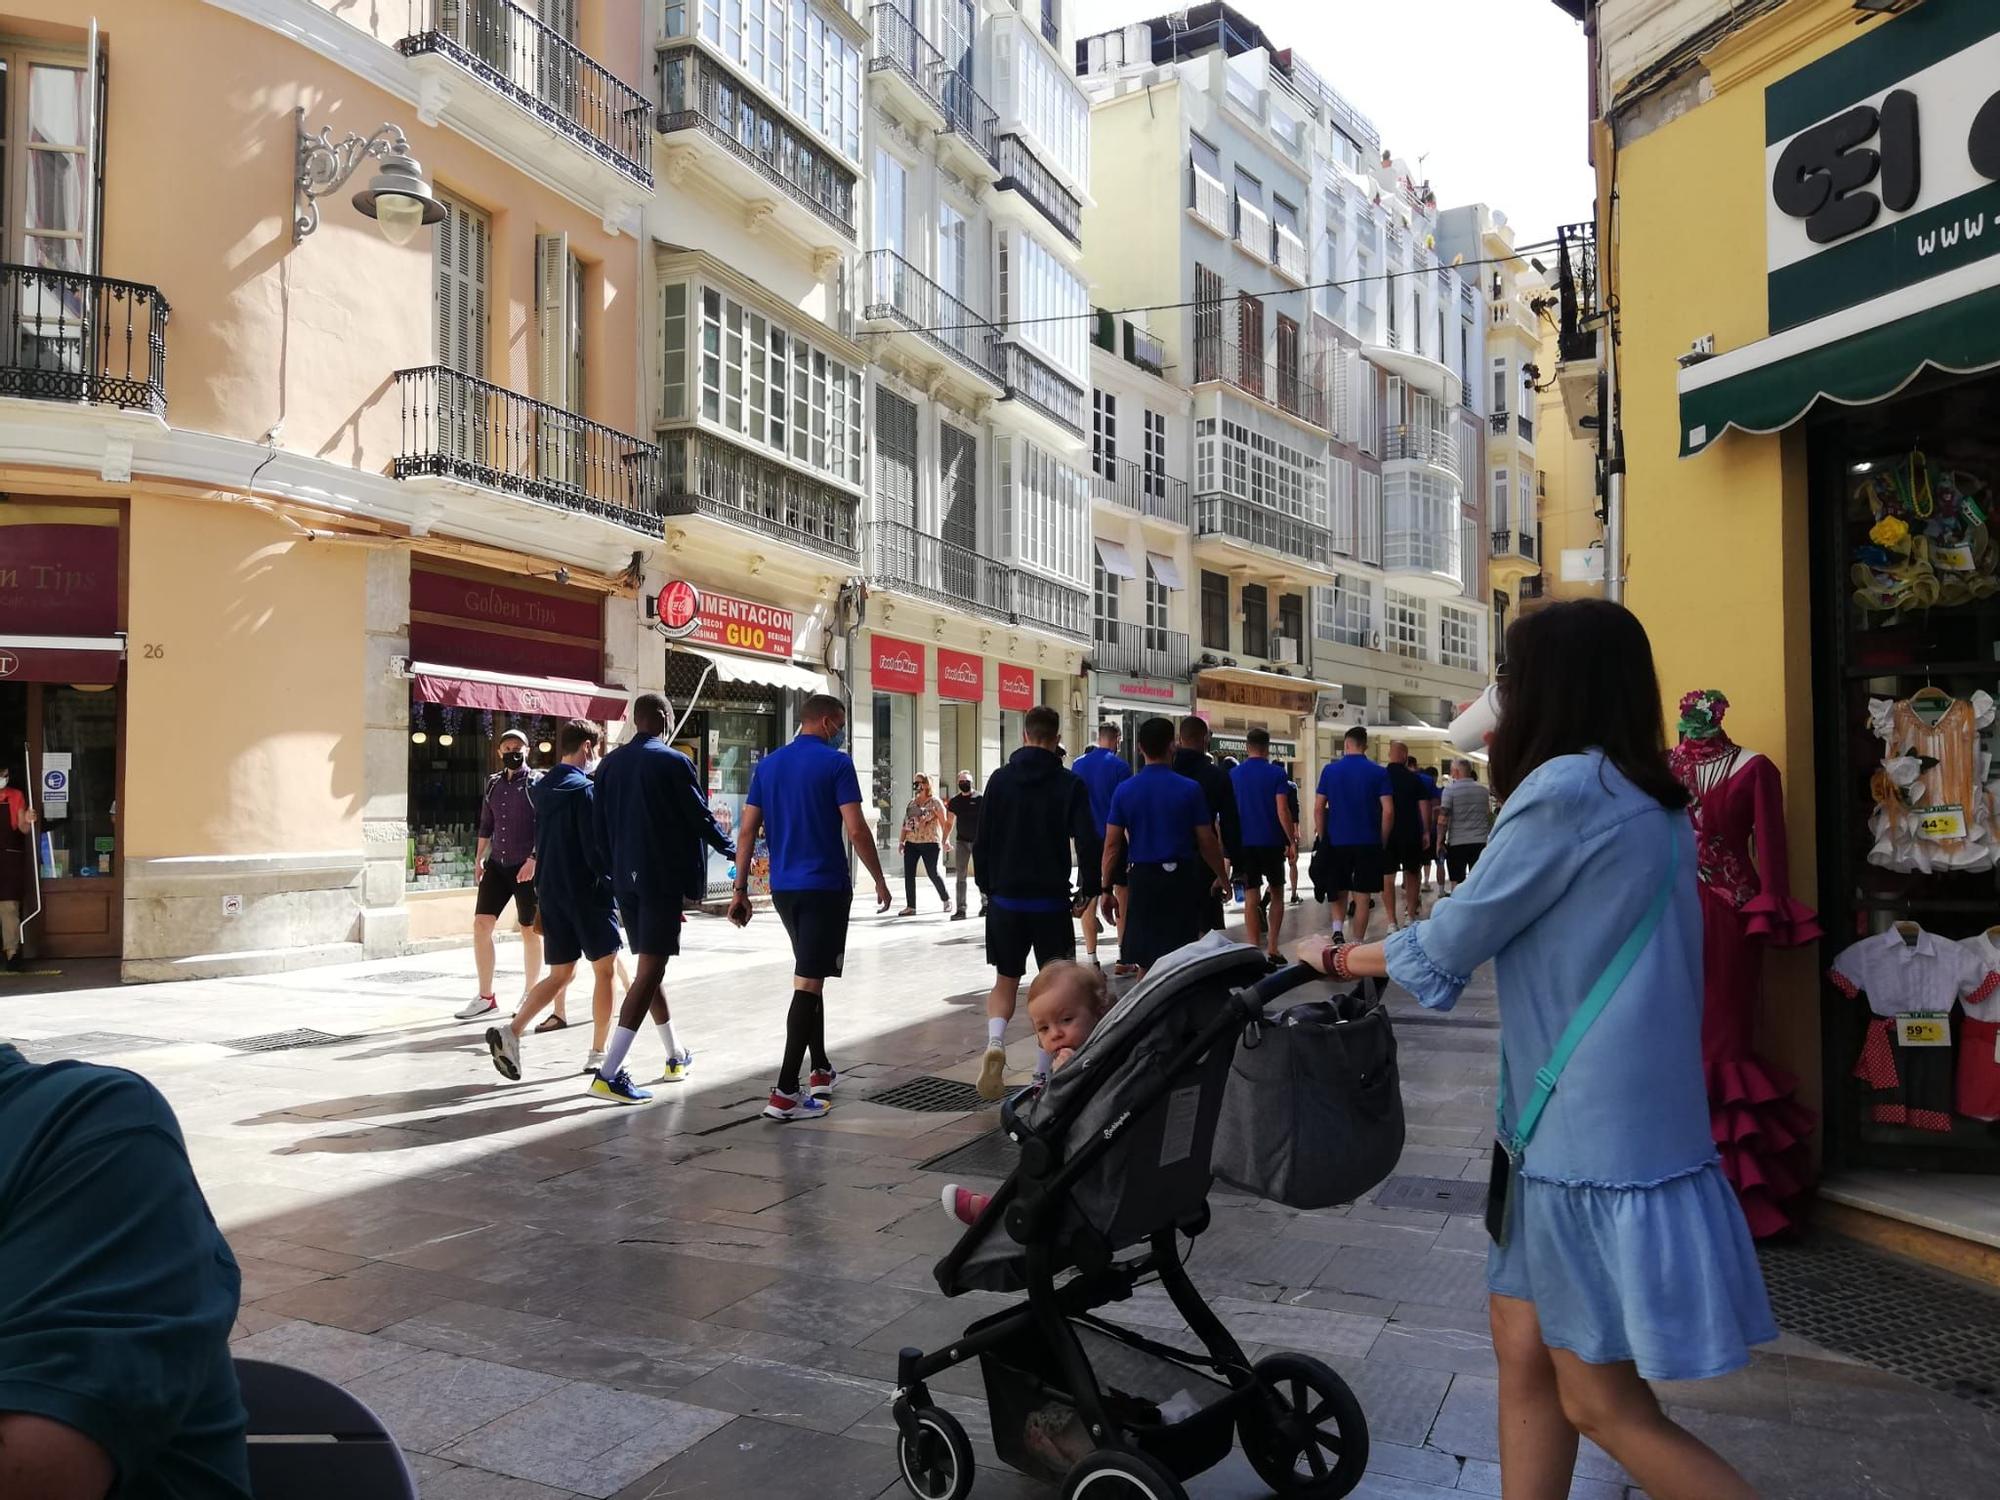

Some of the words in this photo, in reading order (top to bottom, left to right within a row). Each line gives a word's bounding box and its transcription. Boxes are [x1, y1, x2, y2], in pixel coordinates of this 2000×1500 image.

[30, 564, 97, 596] Tips
[465, 588, 520, 618] Golden
[525, 601, 556, 626] Tips
[700, 594, 792, 630] IMENTACION
[726, 623, 765, 650] GUO
[773, 644, 785, 654] PAN
[144, 644, 164, 659] 26
[1906, 1025, 1923, 1035] 59
